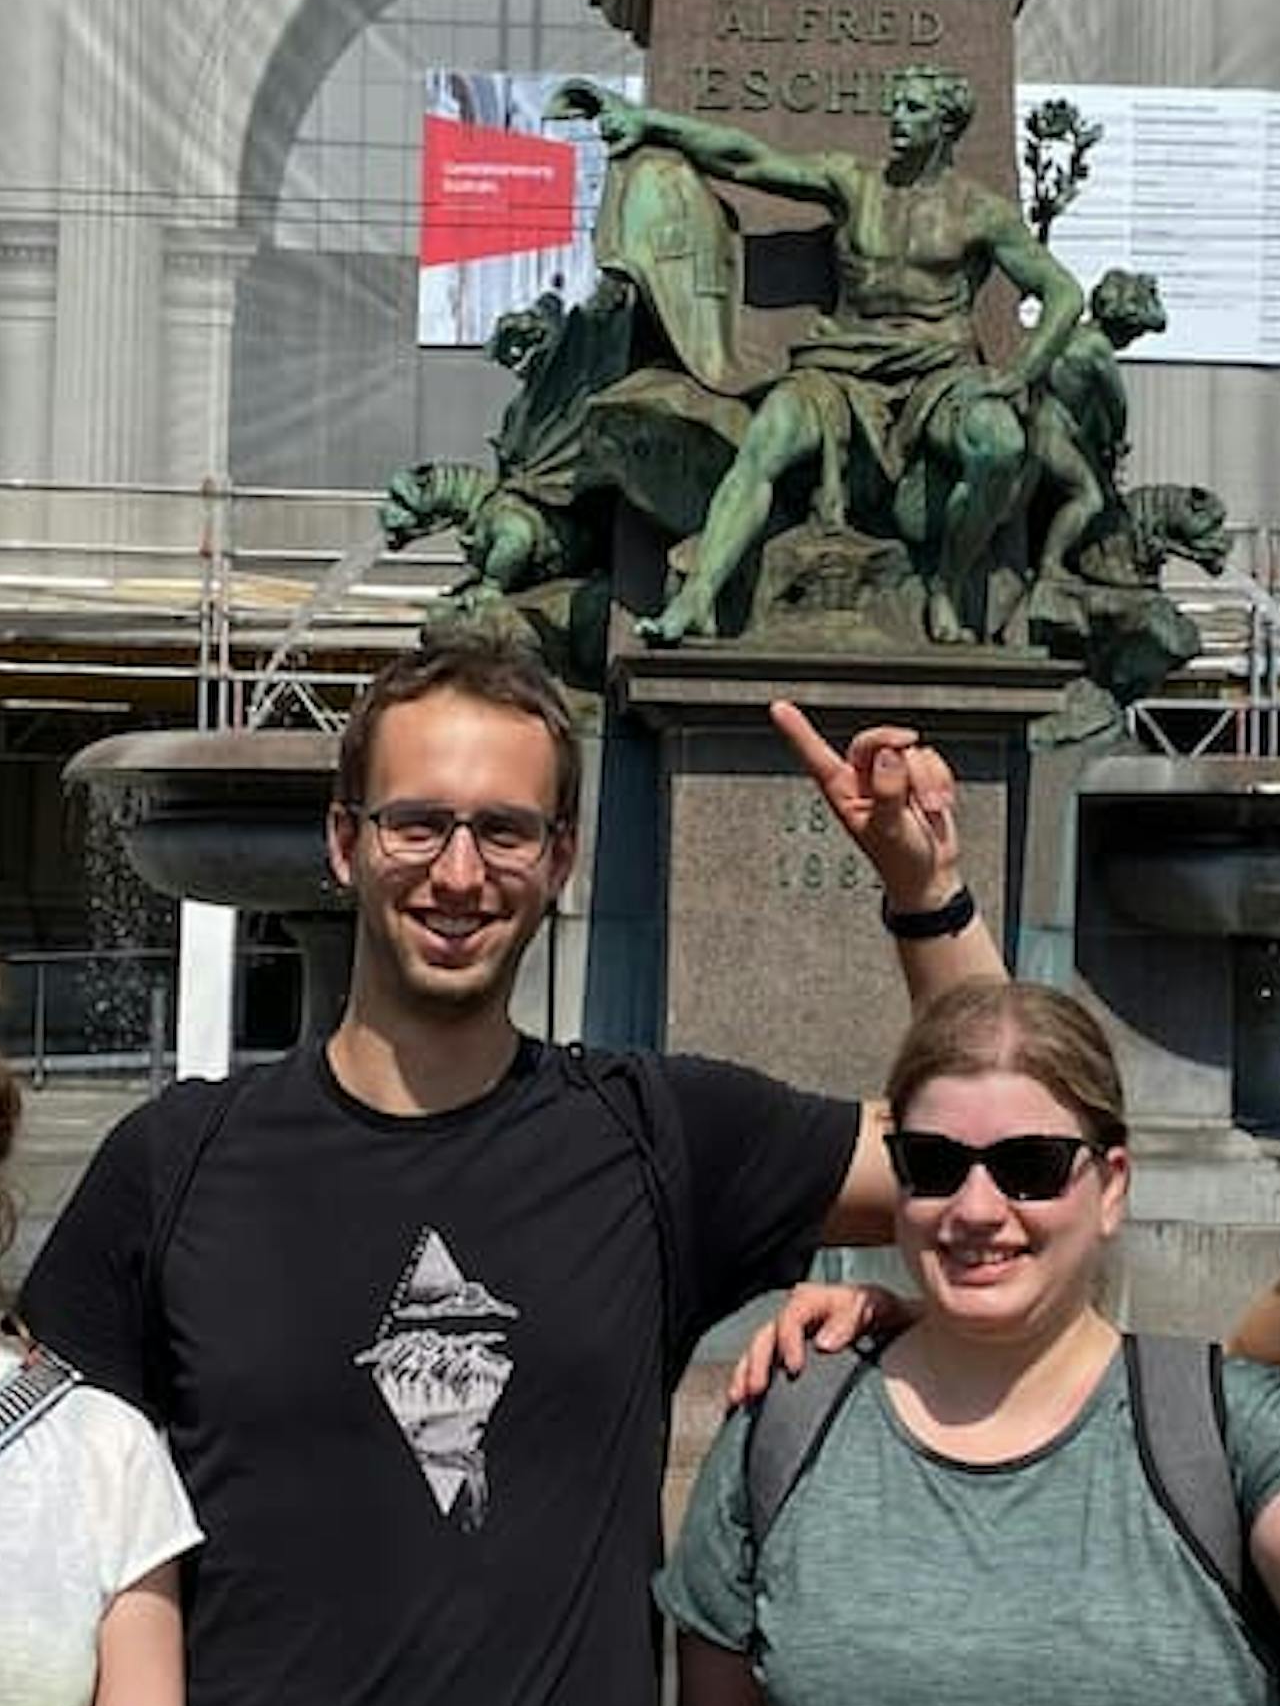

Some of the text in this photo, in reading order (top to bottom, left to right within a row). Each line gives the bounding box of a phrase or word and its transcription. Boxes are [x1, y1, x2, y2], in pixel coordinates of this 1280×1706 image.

[716, 0, 943, 47] ALFRED
[693, 63, 898, 115] ESCH
[782, 796, 830, 834] 18
[777, 852, 883, 891] 188
